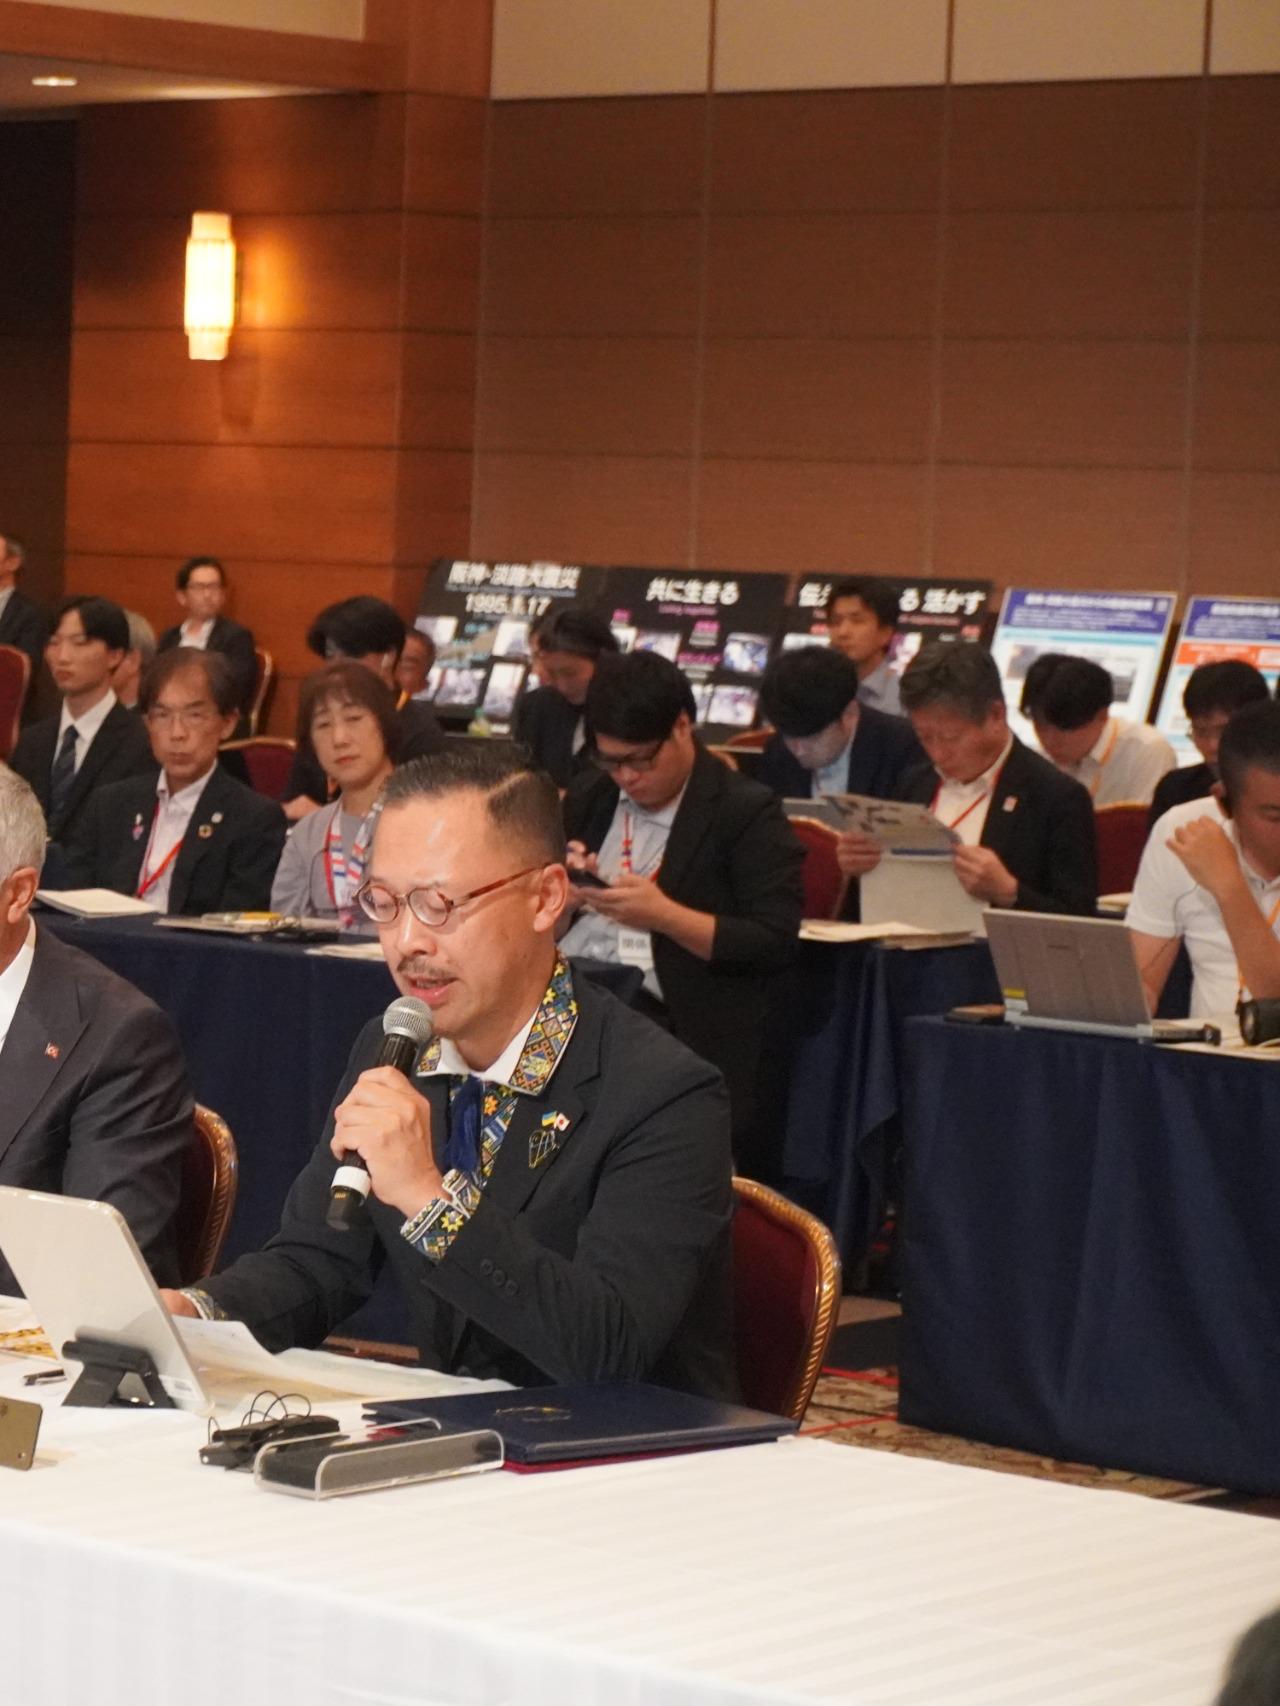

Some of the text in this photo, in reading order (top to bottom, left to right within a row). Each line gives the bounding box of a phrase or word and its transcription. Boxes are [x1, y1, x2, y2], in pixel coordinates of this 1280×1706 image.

[645, 577, 740, 606] 共に生きる
